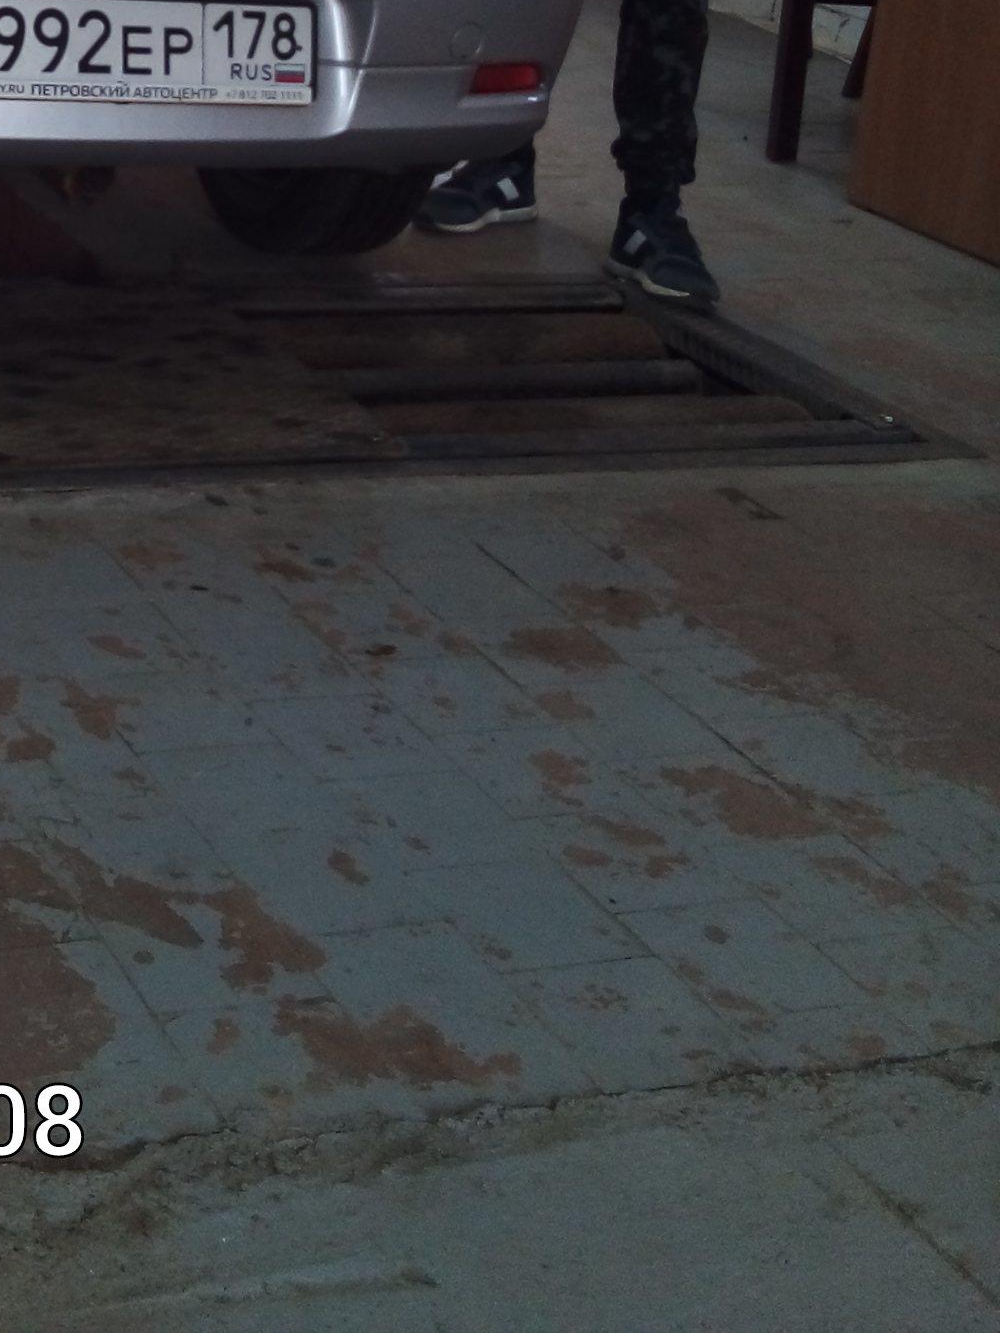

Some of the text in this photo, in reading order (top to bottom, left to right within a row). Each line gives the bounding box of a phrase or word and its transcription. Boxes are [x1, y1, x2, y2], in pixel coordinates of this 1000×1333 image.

[213, 10, 297, 61] 178
[230, 63, 272, 81] RUS
[31, 81, 130, 98] ПЕТРОВСКИЙ
[133, 87, 218, 100] АВТОЦЕНТР
